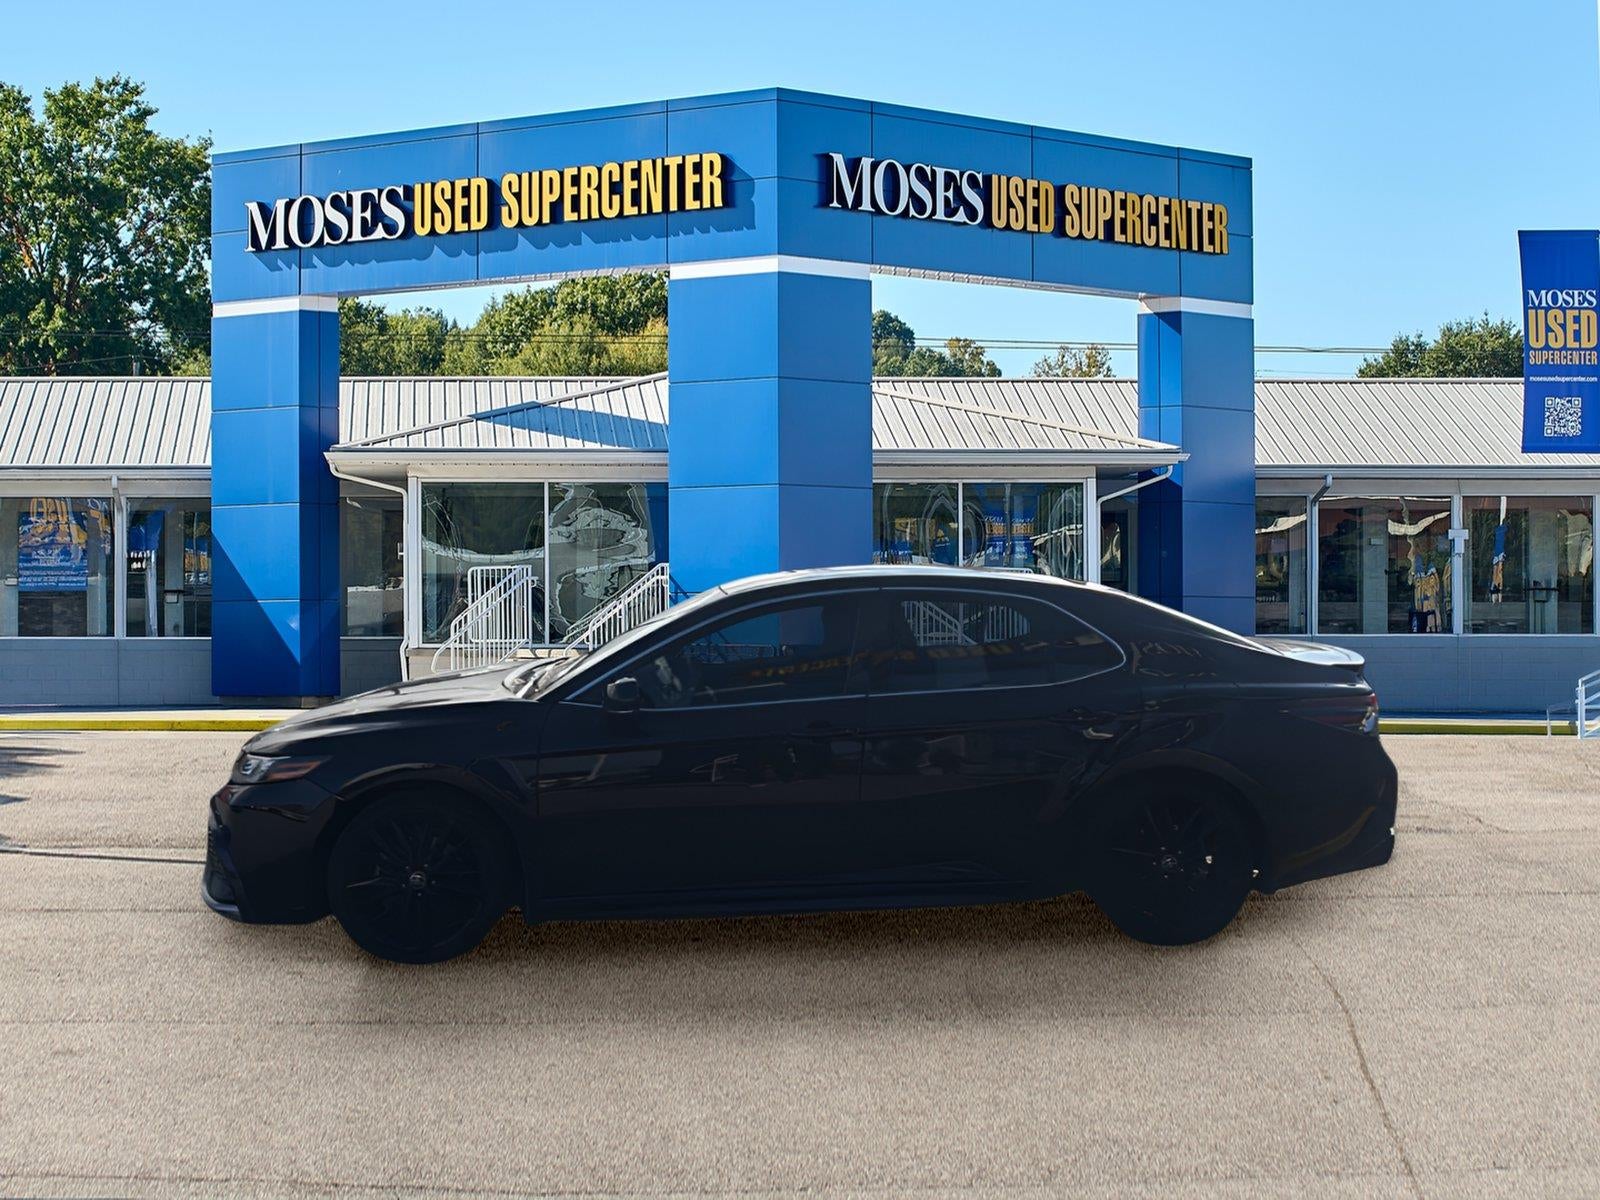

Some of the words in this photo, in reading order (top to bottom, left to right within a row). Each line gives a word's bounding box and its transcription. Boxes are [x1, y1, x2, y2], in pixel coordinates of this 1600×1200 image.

[244, 185, 406, 252] MOSES
[412, 177, 488, 237] USED
[500, 152, 724, 229] SUPERCENTER
[829, 152, 985, 226] MOSES
[991, 173, 1055, 234] USED
[1064, 183, 1229, 256] SUPERCENTER
[1527, 289, 1597, 308] MOSES
[1528, 309, 1598, 349] USED
[1529, 350, 1598, 365] SUPERCENTER
